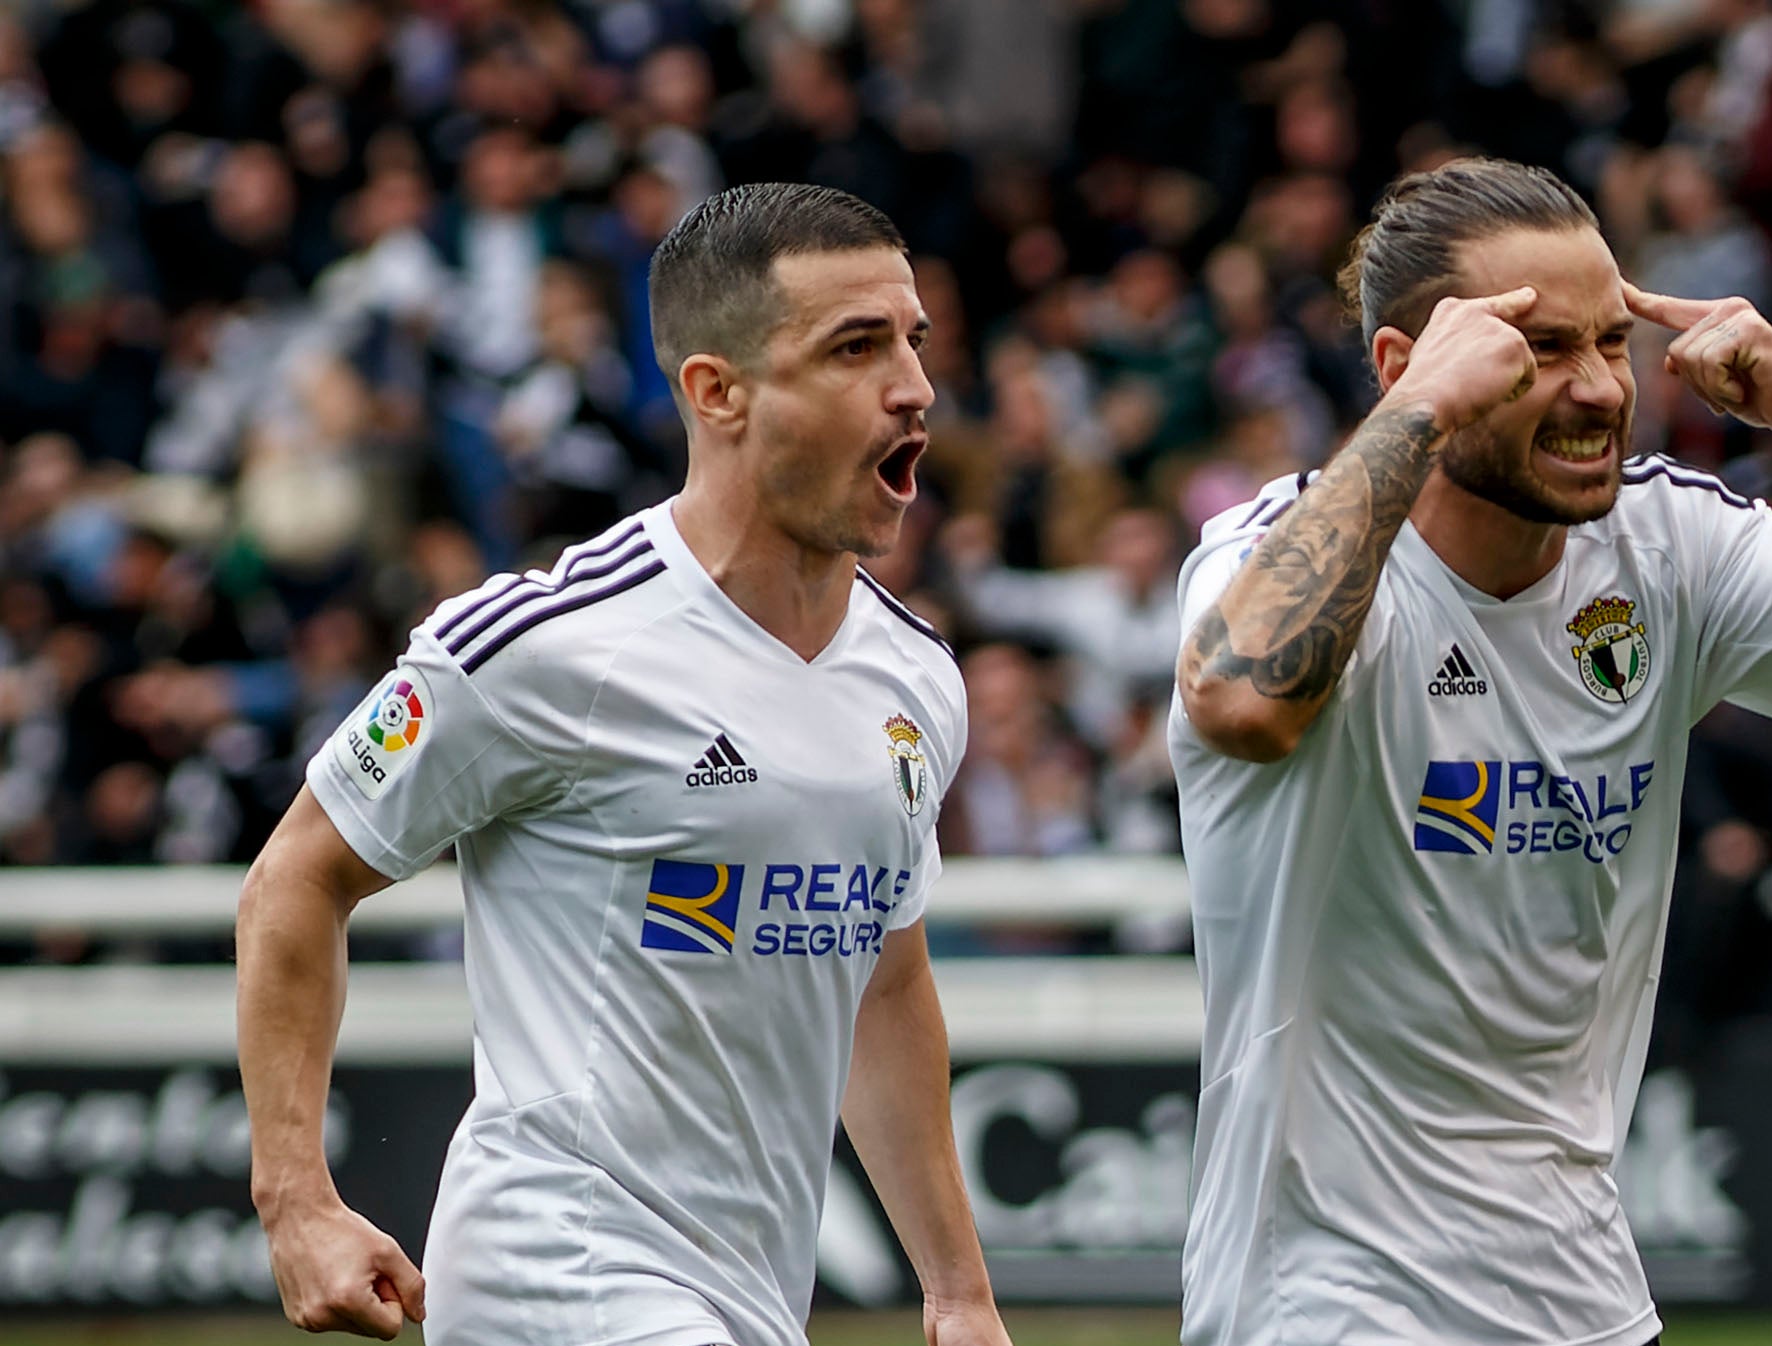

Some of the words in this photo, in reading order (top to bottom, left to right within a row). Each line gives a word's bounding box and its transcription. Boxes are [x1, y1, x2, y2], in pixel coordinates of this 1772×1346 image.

[1594, 625, 1620, 640] CLUB
[1428, 677, 1488, 696] adidas
[1582, 658, 1608, 697] BURGOS
[348, 730, 387, 784] aLiga
[686, 766, 758, 788] adidas
